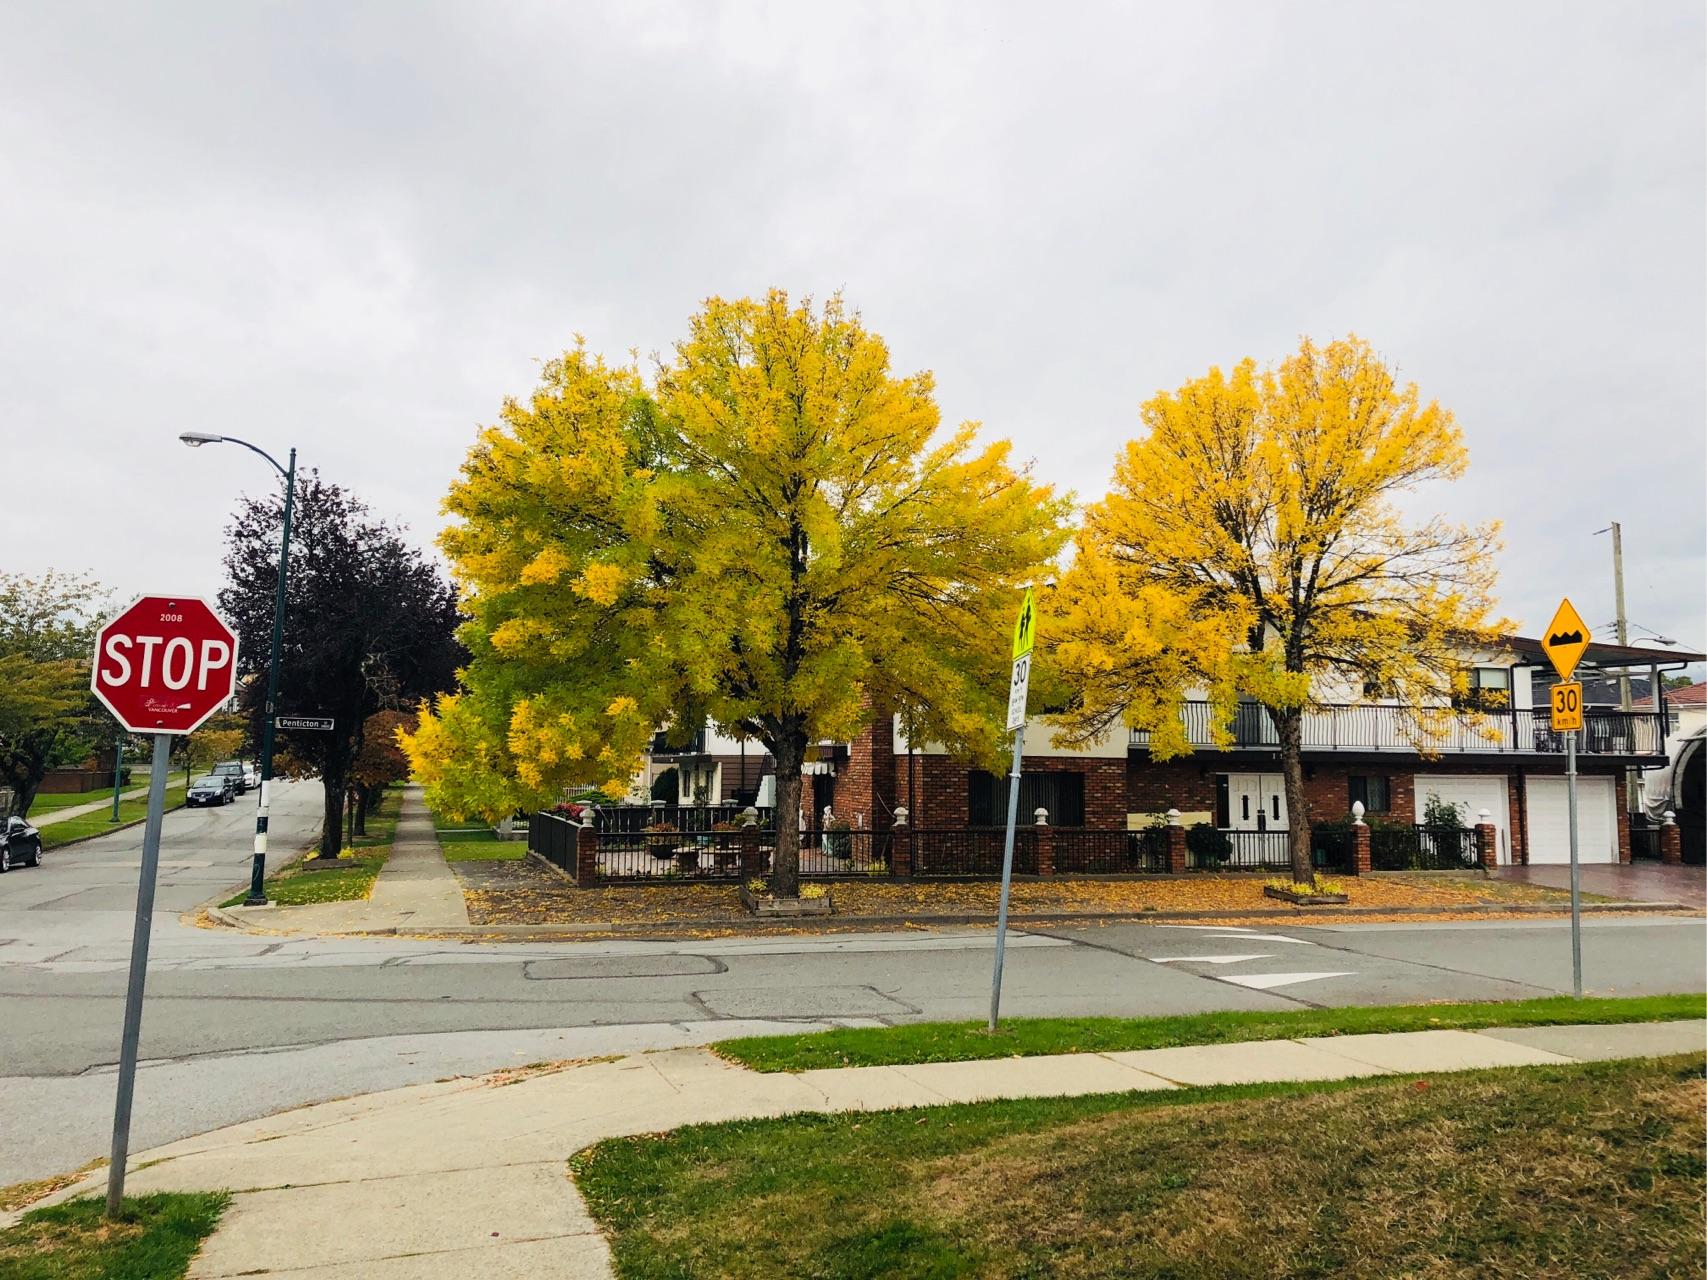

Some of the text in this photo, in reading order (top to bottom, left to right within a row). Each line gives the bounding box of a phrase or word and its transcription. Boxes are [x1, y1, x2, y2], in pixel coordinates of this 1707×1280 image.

[160, 613, 183, 622] 2008
[101, 633, 230, 691] STOP
[1013, 660, 1027, 686] 30
[1556, 689, 1577, 713] 30
[282, 719, 319, 728] Penticton
